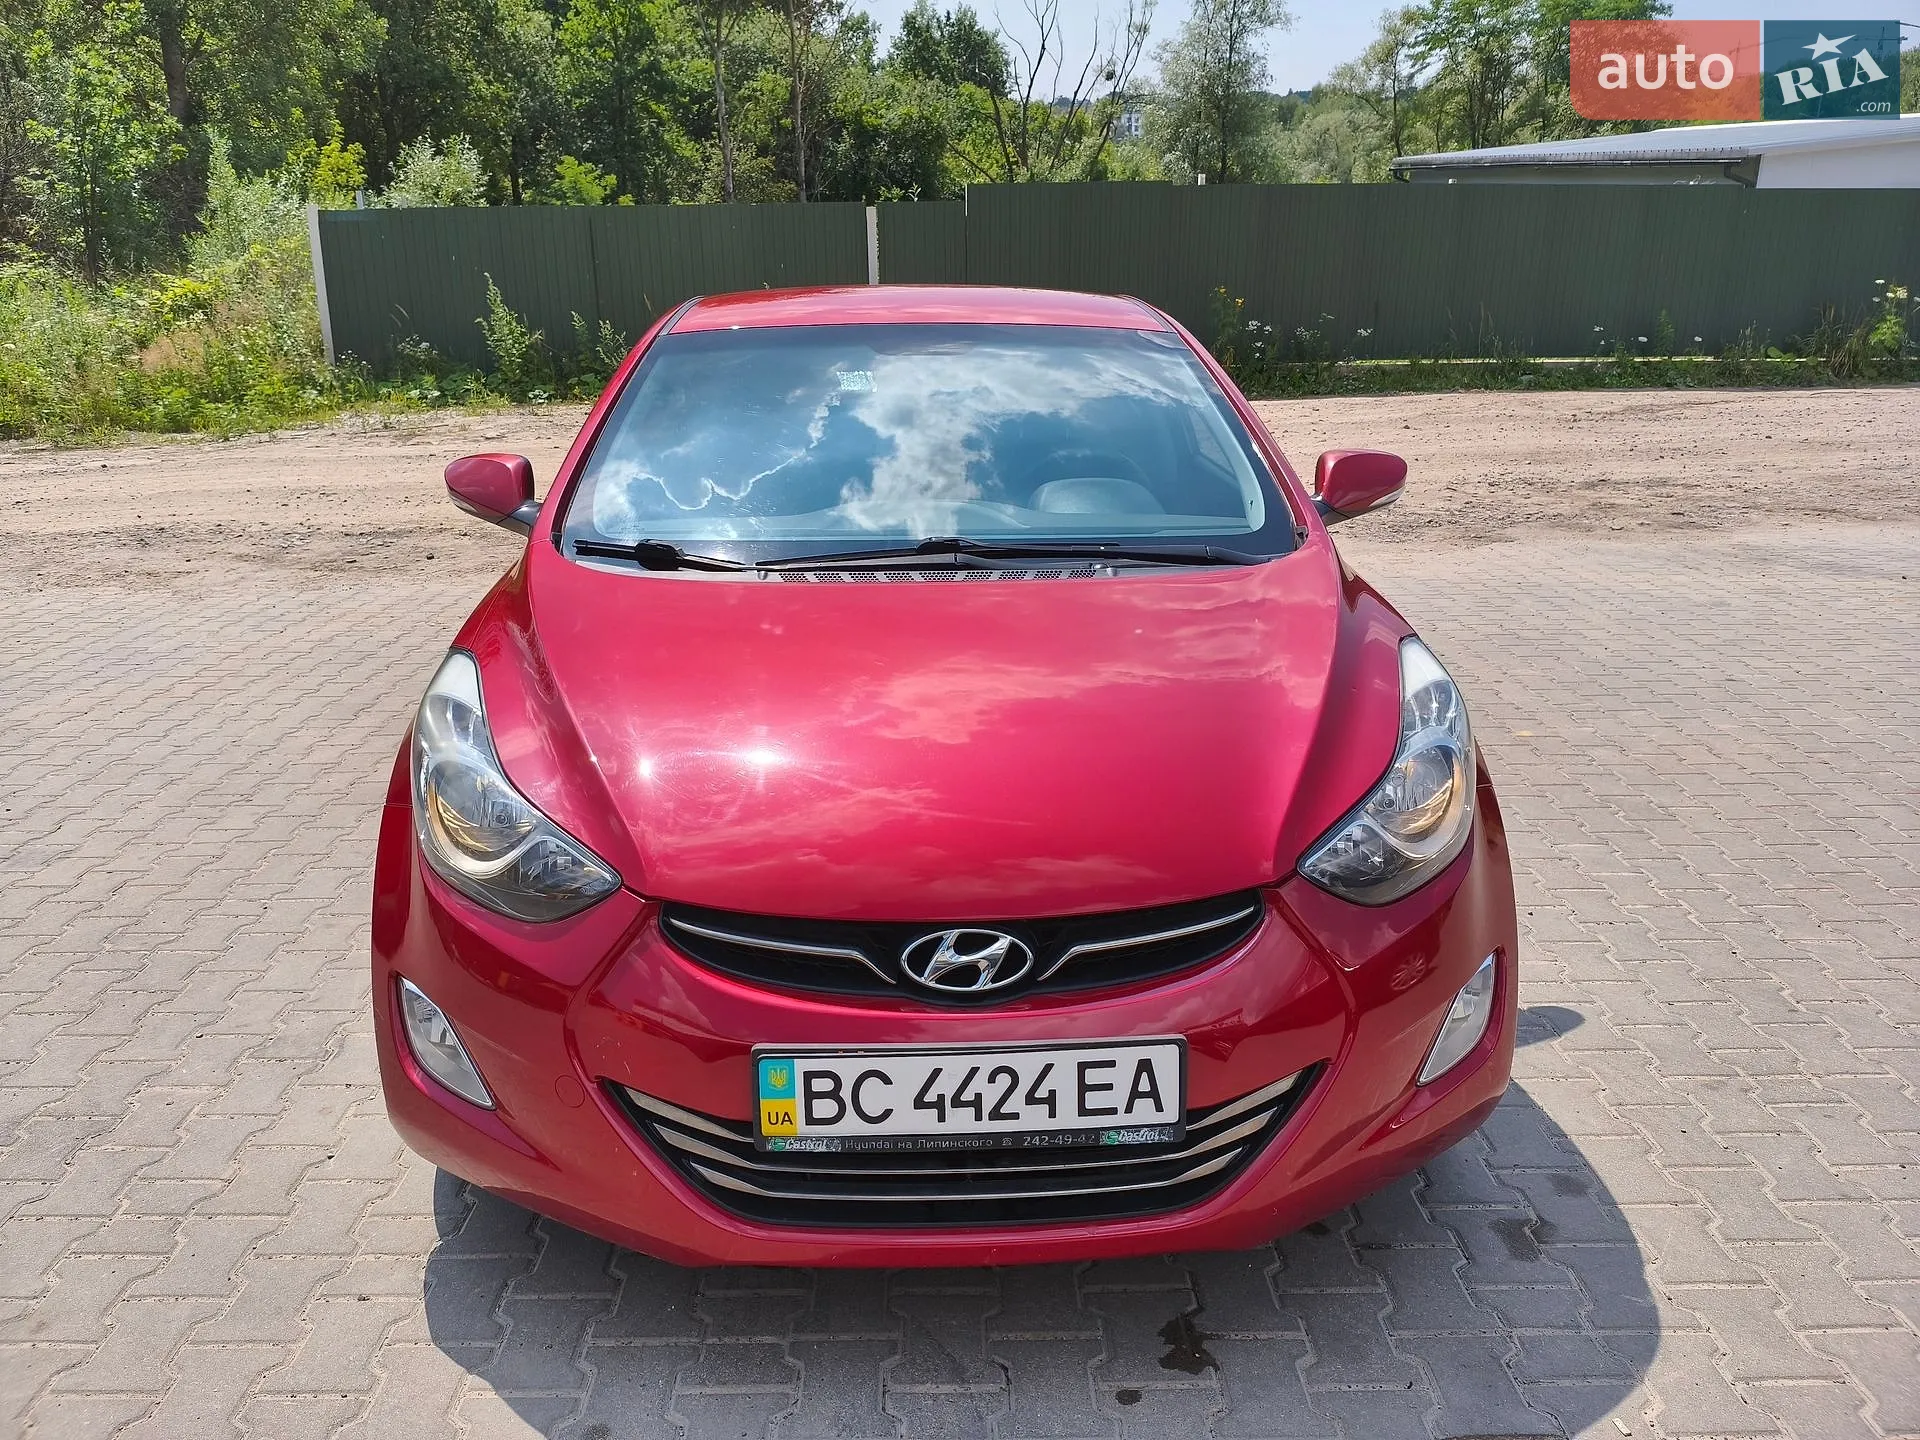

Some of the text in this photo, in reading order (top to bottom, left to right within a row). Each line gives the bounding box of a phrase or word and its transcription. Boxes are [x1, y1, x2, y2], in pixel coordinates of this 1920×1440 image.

[803, 1057, 1165, 1127] BC 4424 EA
[767, 1111, 794, 1126] UA
[845, 1139, 894, 1151] Hyundai
[898, 1141, 912, 1150] на
[916, 1139, 993, 1150] Липинского
